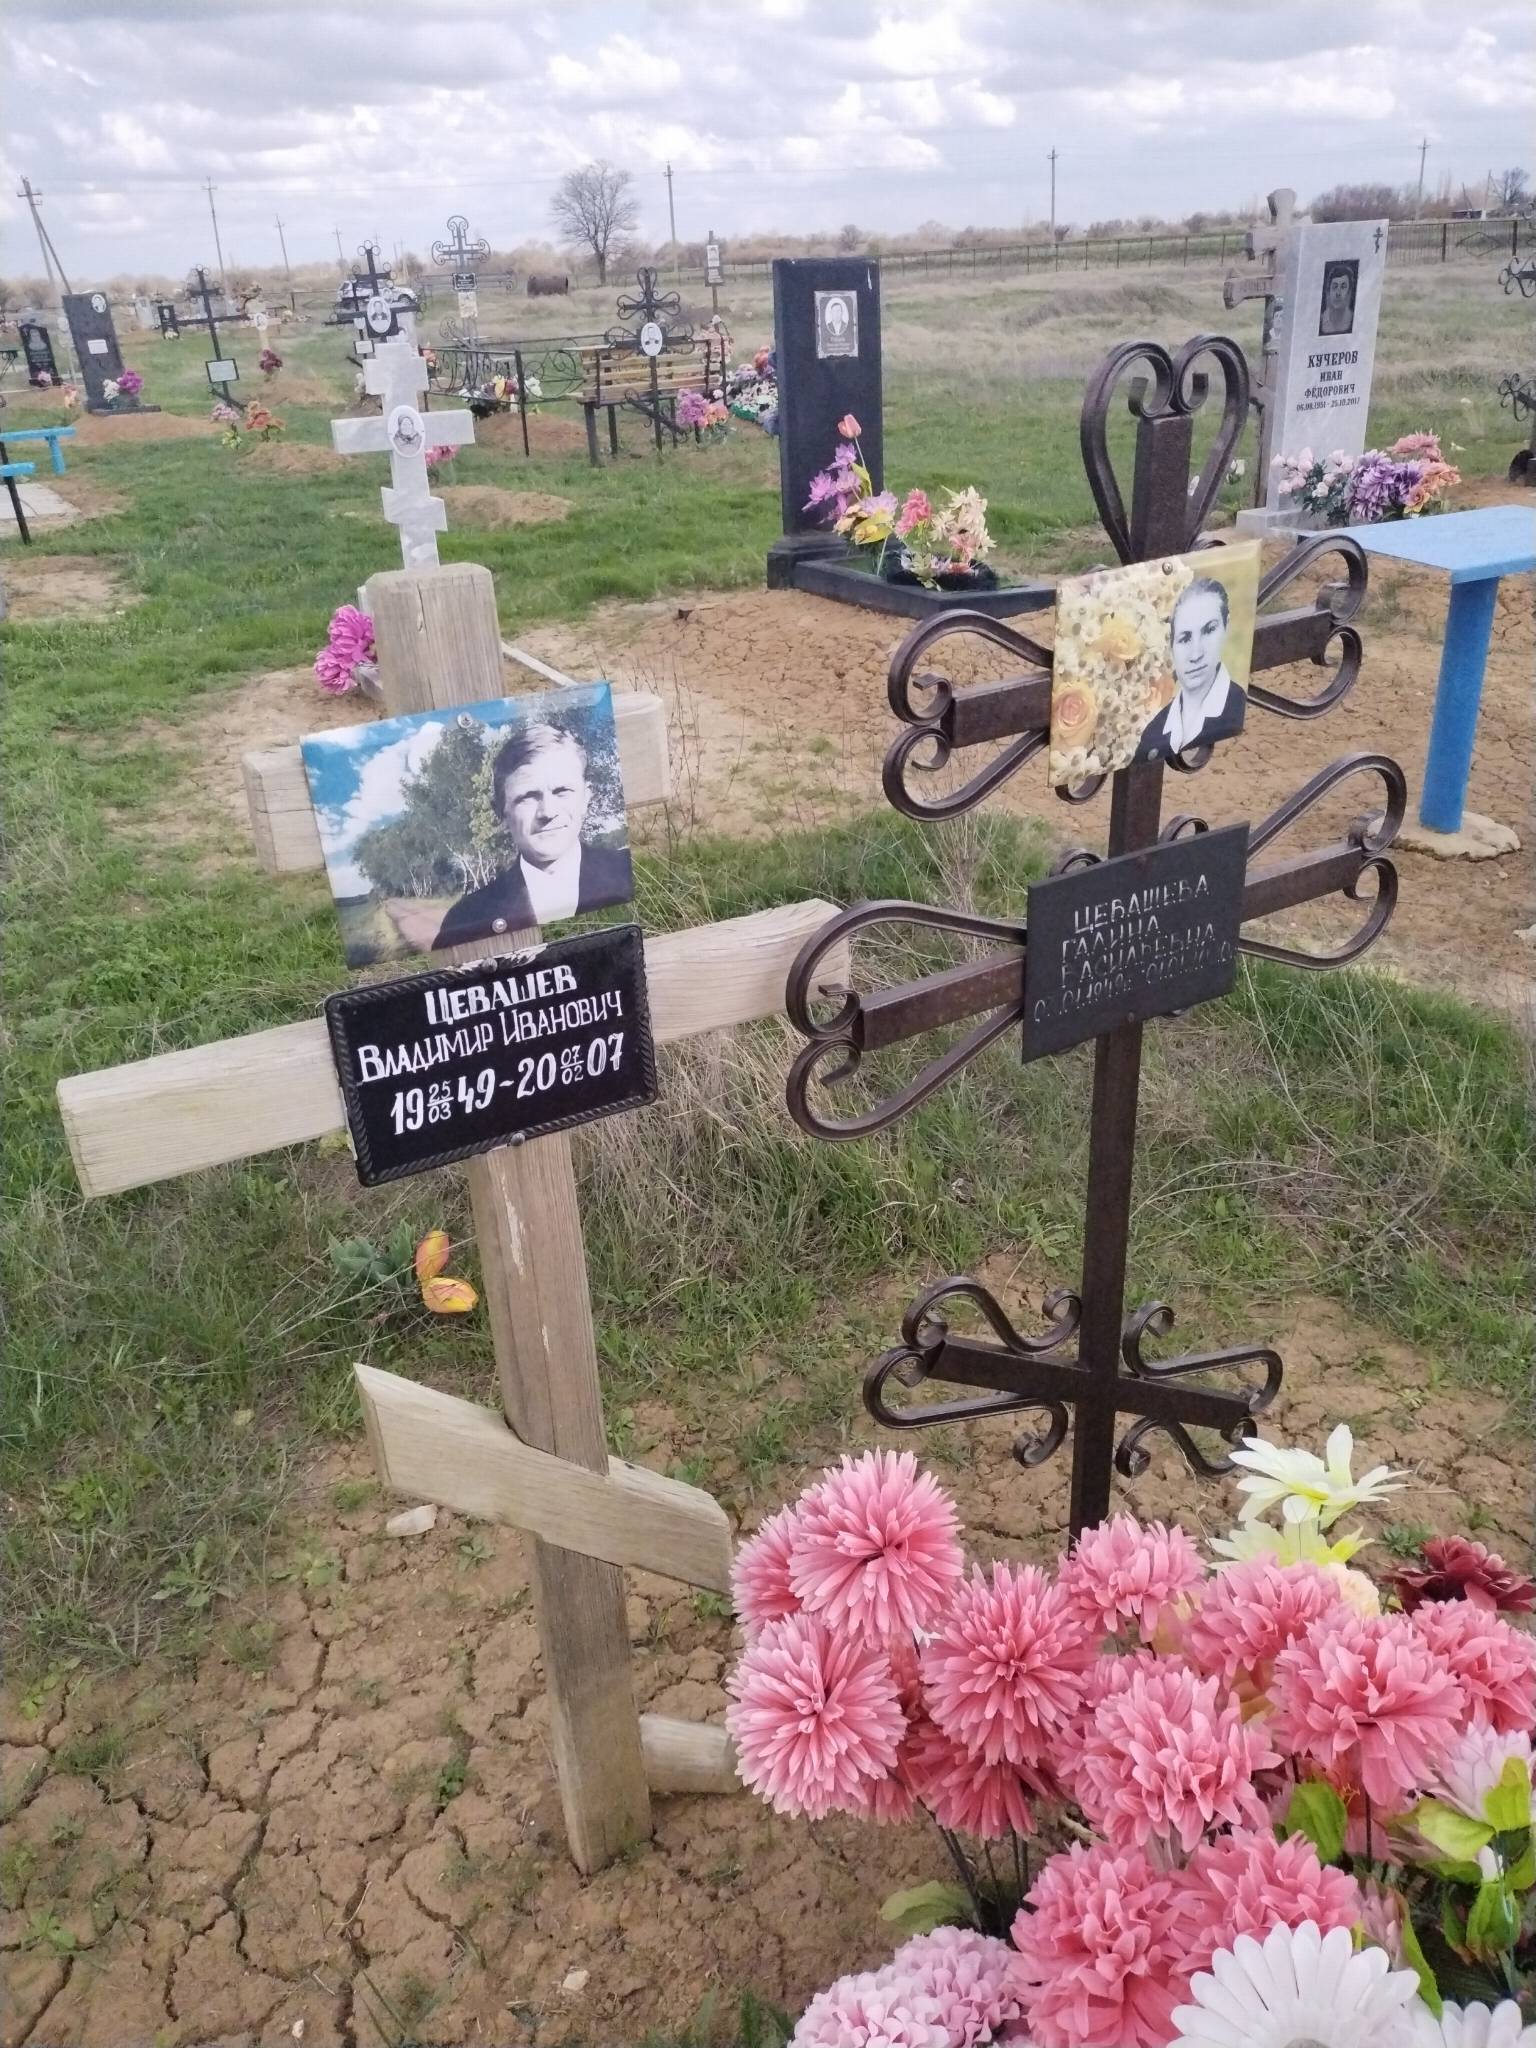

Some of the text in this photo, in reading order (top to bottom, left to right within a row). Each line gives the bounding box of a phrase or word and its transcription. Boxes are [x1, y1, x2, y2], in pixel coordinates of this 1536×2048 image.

[1307, 350, 1359, 368] КУЧЕРОВ
[1320, 370, 1343, 382] ИВАН
[1074, 874, 1211, 934] ЦЕВАШЕВА
[1062, 914, 1161, 964] ГАЛИНА
[424, 964, 577, 1025] ЦЕВАШЕВ
[499, 990, 623, 1046] ИВАНОВИЧ
